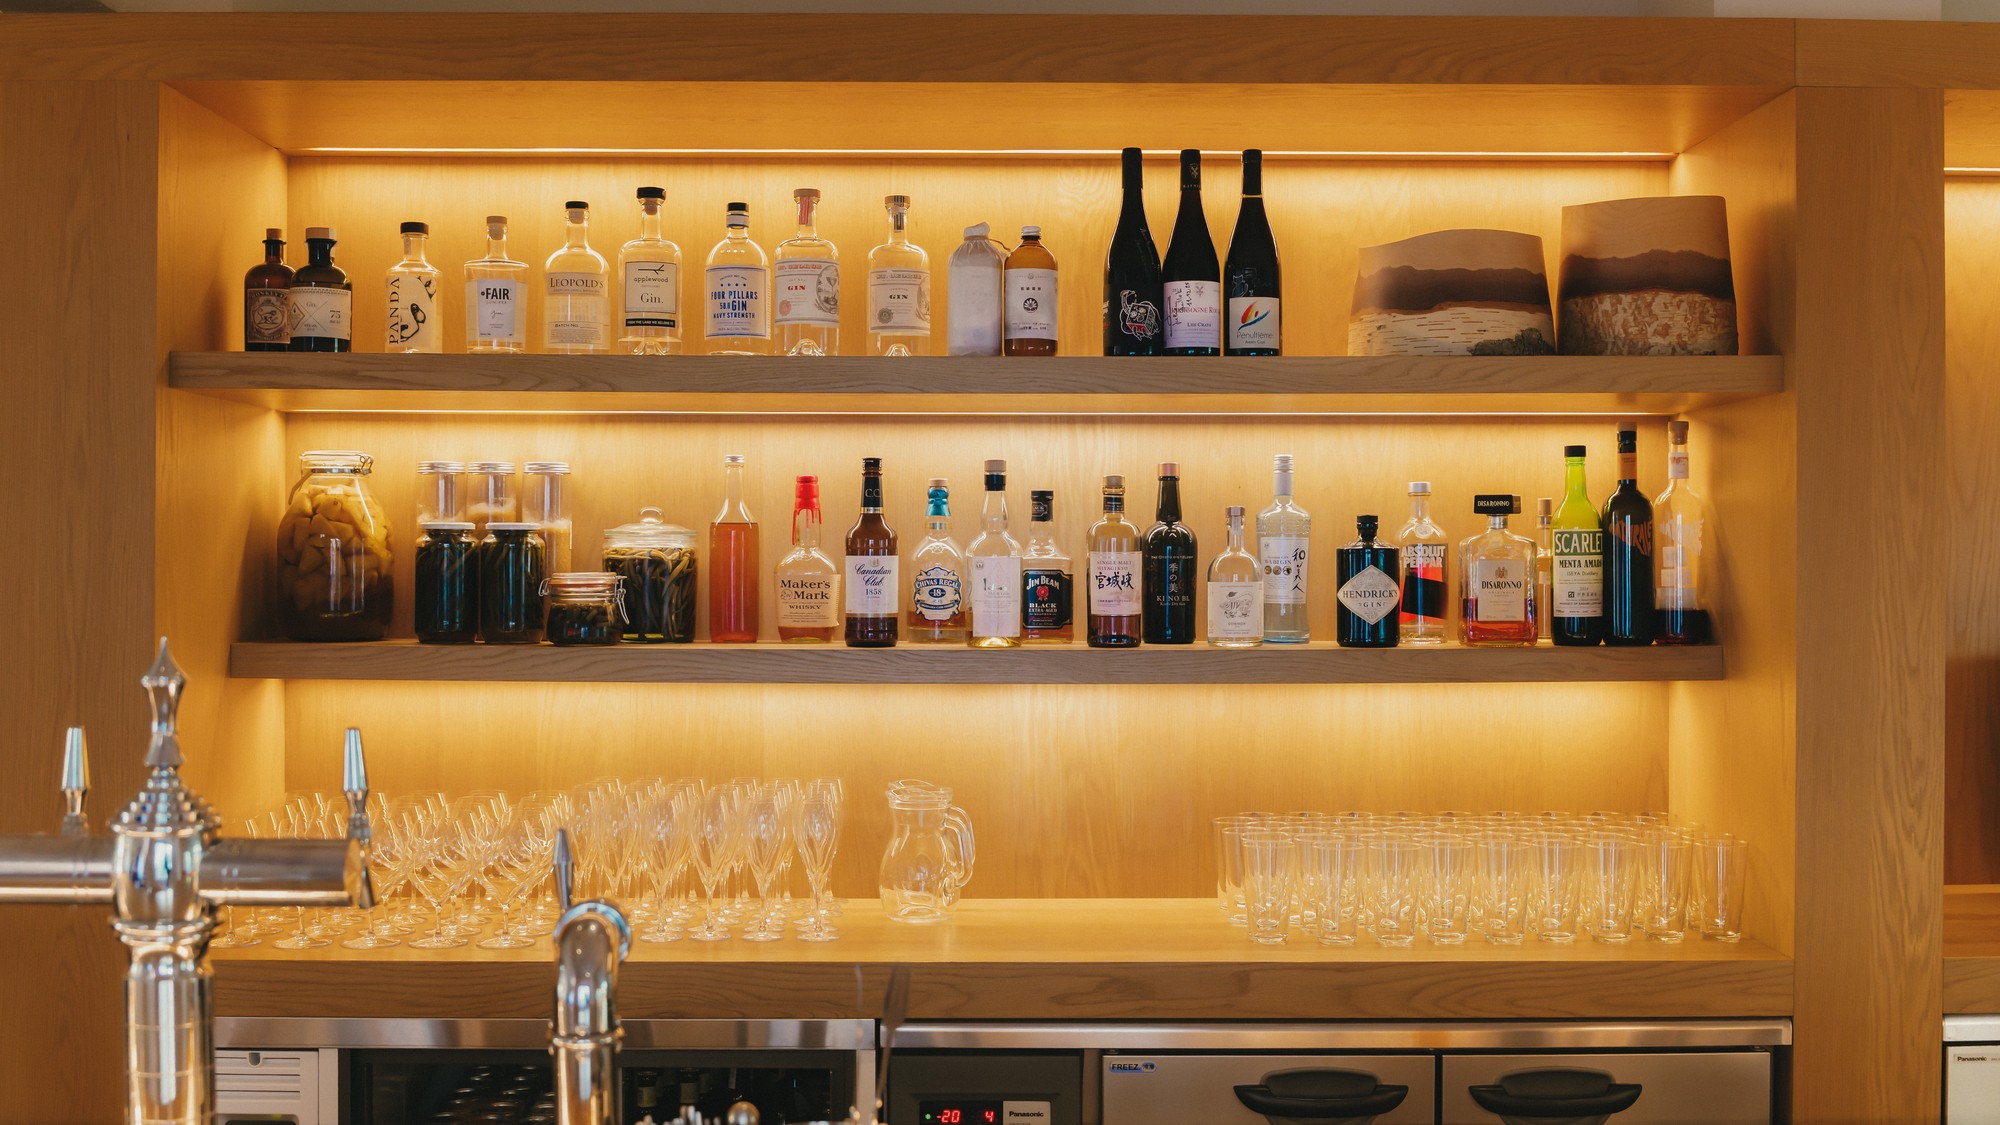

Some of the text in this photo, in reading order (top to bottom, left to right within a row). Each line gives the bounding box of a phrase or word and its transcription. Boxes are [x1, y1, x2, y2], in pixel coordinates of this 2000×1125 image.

[550, 277, 604, 288] LEOPOLD'S
[711, 290, 758, 300] FOUR PILLARS
[732, 300, 747, 311] GIN
[330, 310, 340, 319] 75
[389, 278, 400, 344] PANDA
[1402, 546, 1446, 558] ABSOLUT
[1404, 556, 1443, 568] PEPPAR
[1559, 560, 1581, 568] MENTA
[854, 564, 892, 575] Canadian
[780, 580, 830, 589] Maker's
[916, 579, 959, 589] CHIVAS REGAL
[1026, 576, 1060, 590] JIM BEAM
[1095, 571, 1134, 590] 宮城峡
[1481, 581, 1522, 590] DISARONNO
[794, 590, 830, 600] Mark
[933, 589, 942, 597] 18
[1342, 589, 1398, 598] HENDRICK'S
[936, 1110, 994, 1123] -20 4
